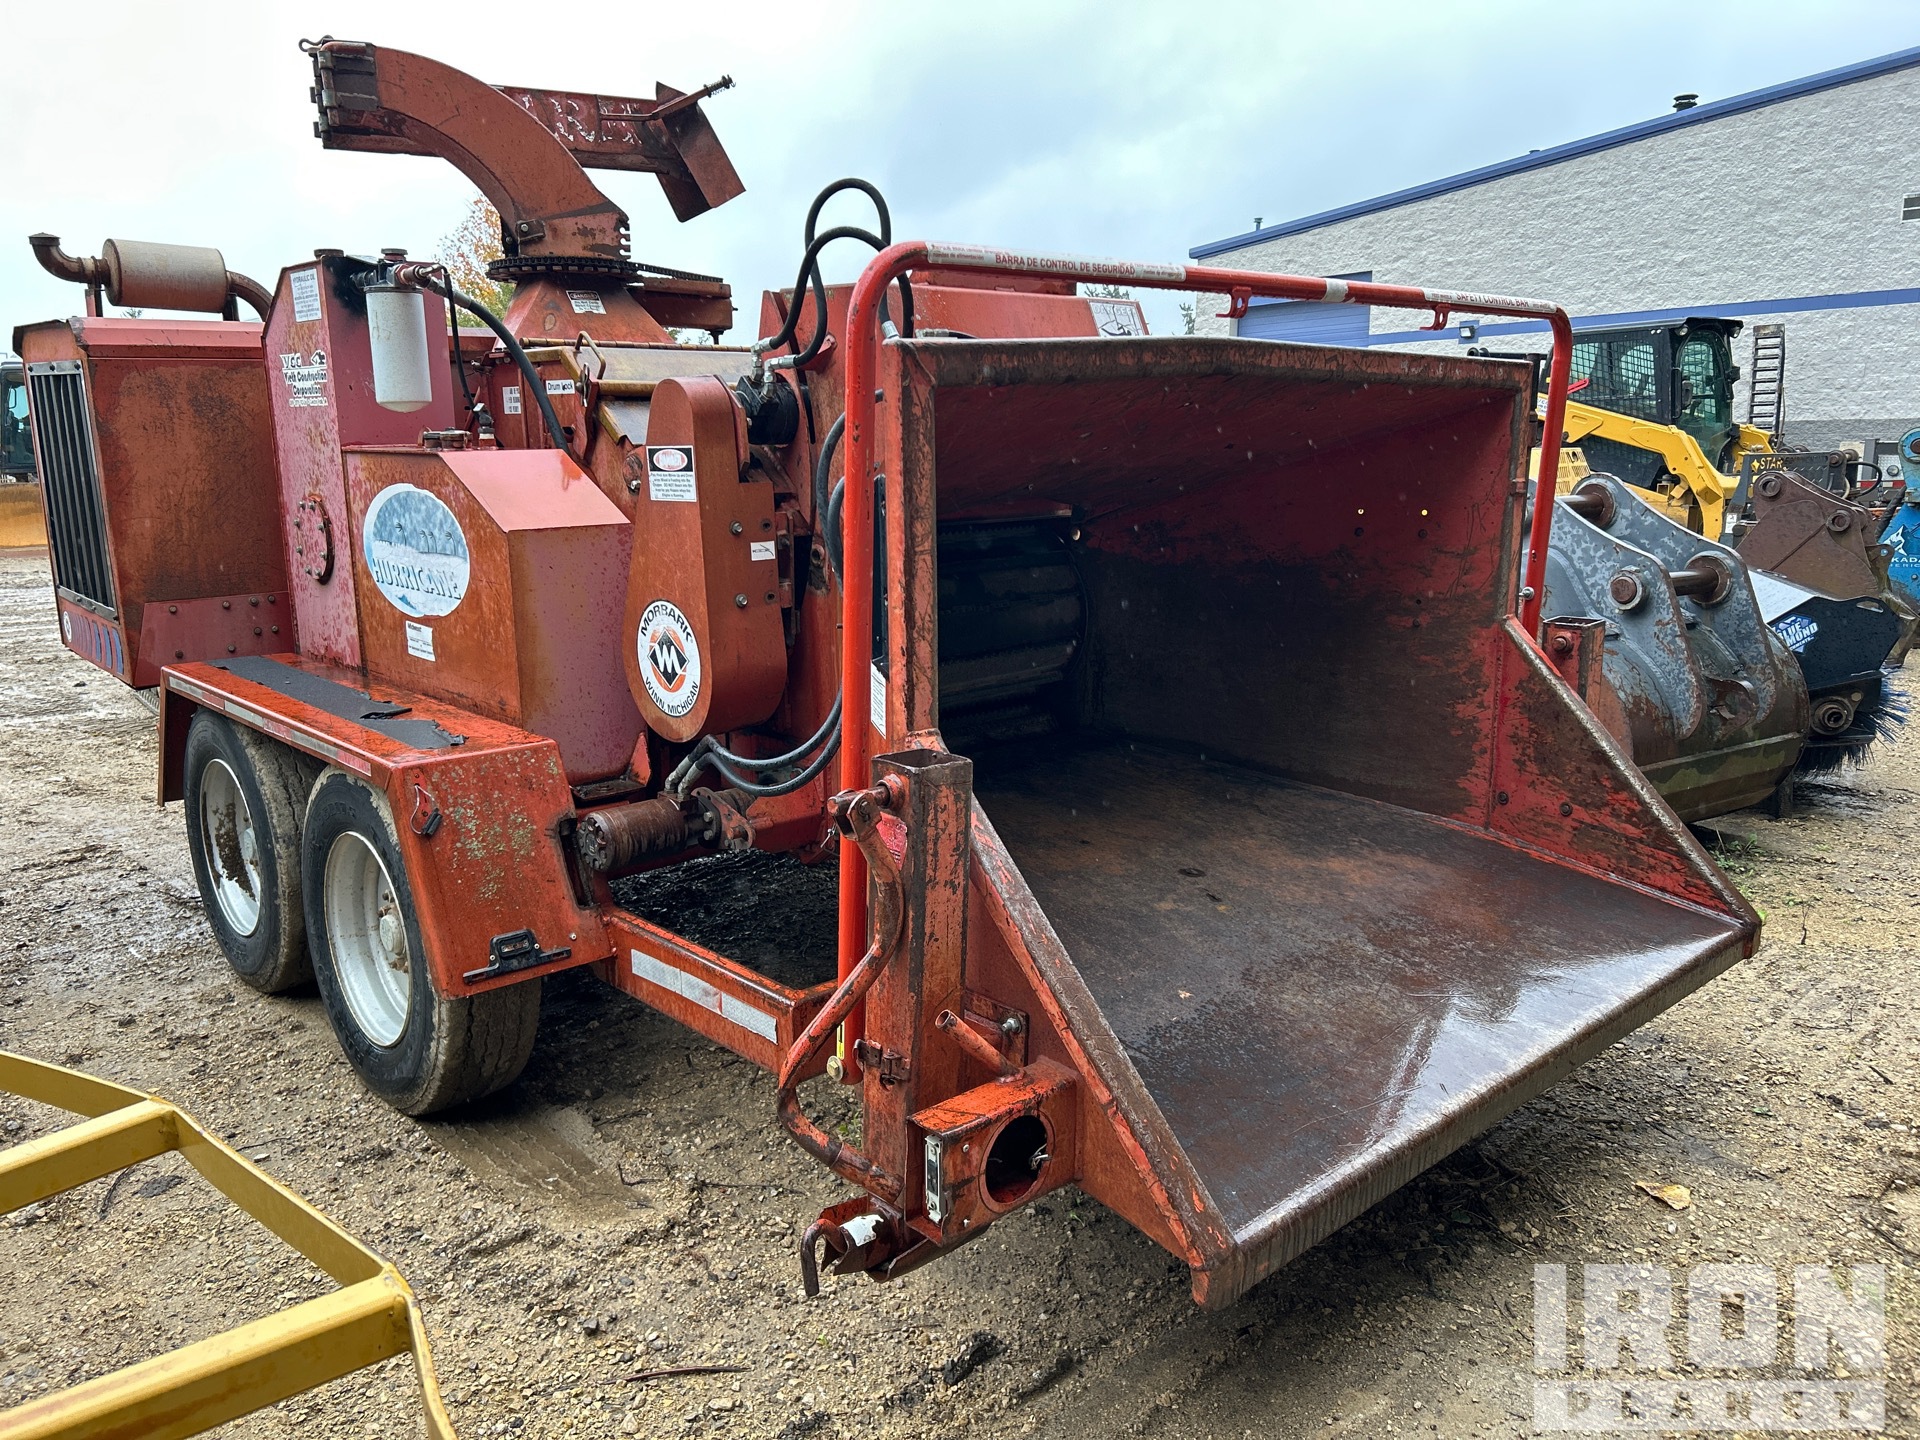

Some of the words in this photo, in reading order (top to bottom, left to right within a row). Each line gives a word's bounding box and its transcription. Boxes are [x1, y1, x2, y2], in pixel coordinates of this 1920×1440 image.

[995, 254, 1025, 267] BARRA
[1027, 257, 1038, 267] DE
[1040, 258, 1078, 271] CONTROL
[1081, 262, 1090, 273] DE
[1092, 263, 1135, 276] SEGURIDAD
[1484, 295, 1515, 306] CONTROL
[1516, 299, 1529, 307] BAR
[548, 383, 560, 391] Drum
[1760, 457, 1783, 470] STAR
[372, 558, 462, 600] HURRICANE
[640, 604, 692, 643] MORBARK
[1785, 622, 1818, 647] MOND
[645, 676, 666, 712] WINN,
[667, 681, 699, 715] MICHIGAN
